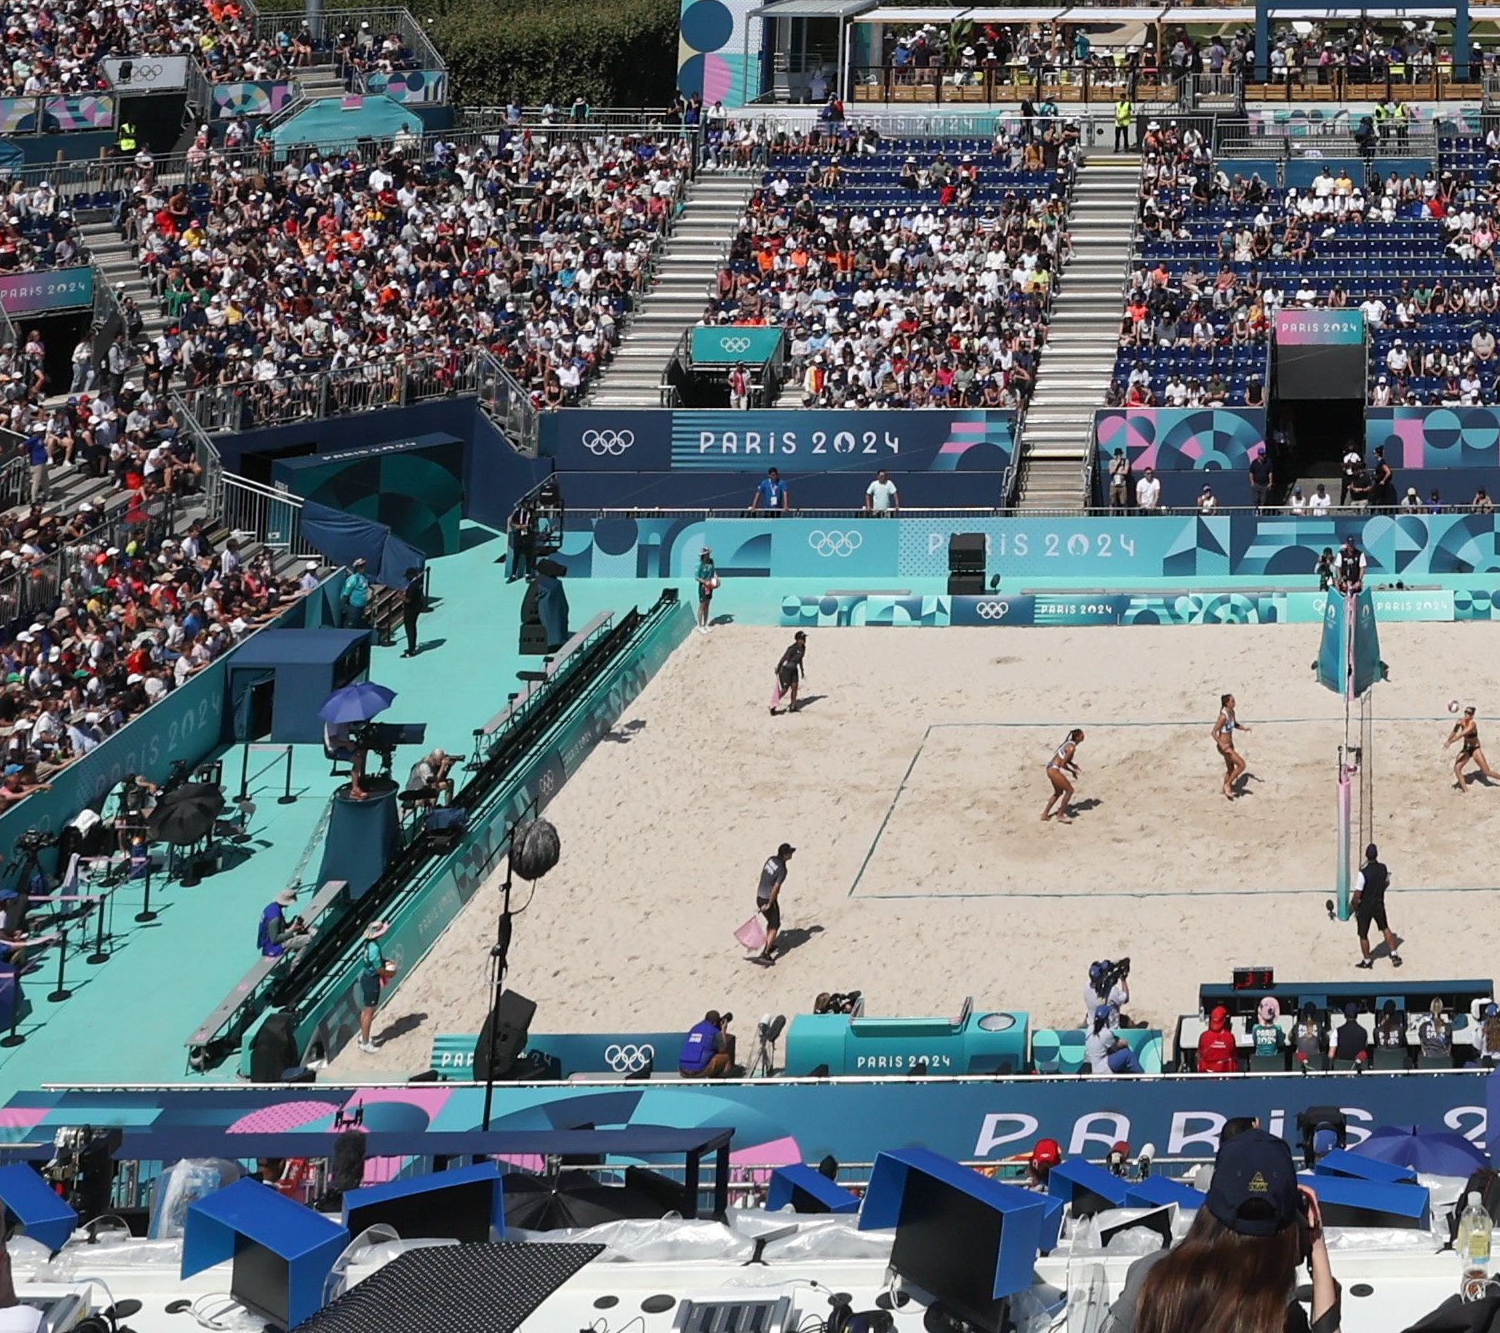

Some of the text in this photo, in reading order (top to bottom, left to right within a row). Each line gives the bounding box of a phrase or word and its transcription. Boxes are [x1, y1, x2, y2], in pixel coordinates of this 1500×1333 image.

[47, 282, 86, 295] 2024
[1323, 323, 1357, 332] 2024
[811, 431, 899, 454] 2024
[1044, 533, 1135, 557] 2024
[1080, 605, 1112, 615] 2024
[908, 1055, 951, 1068] 2024
